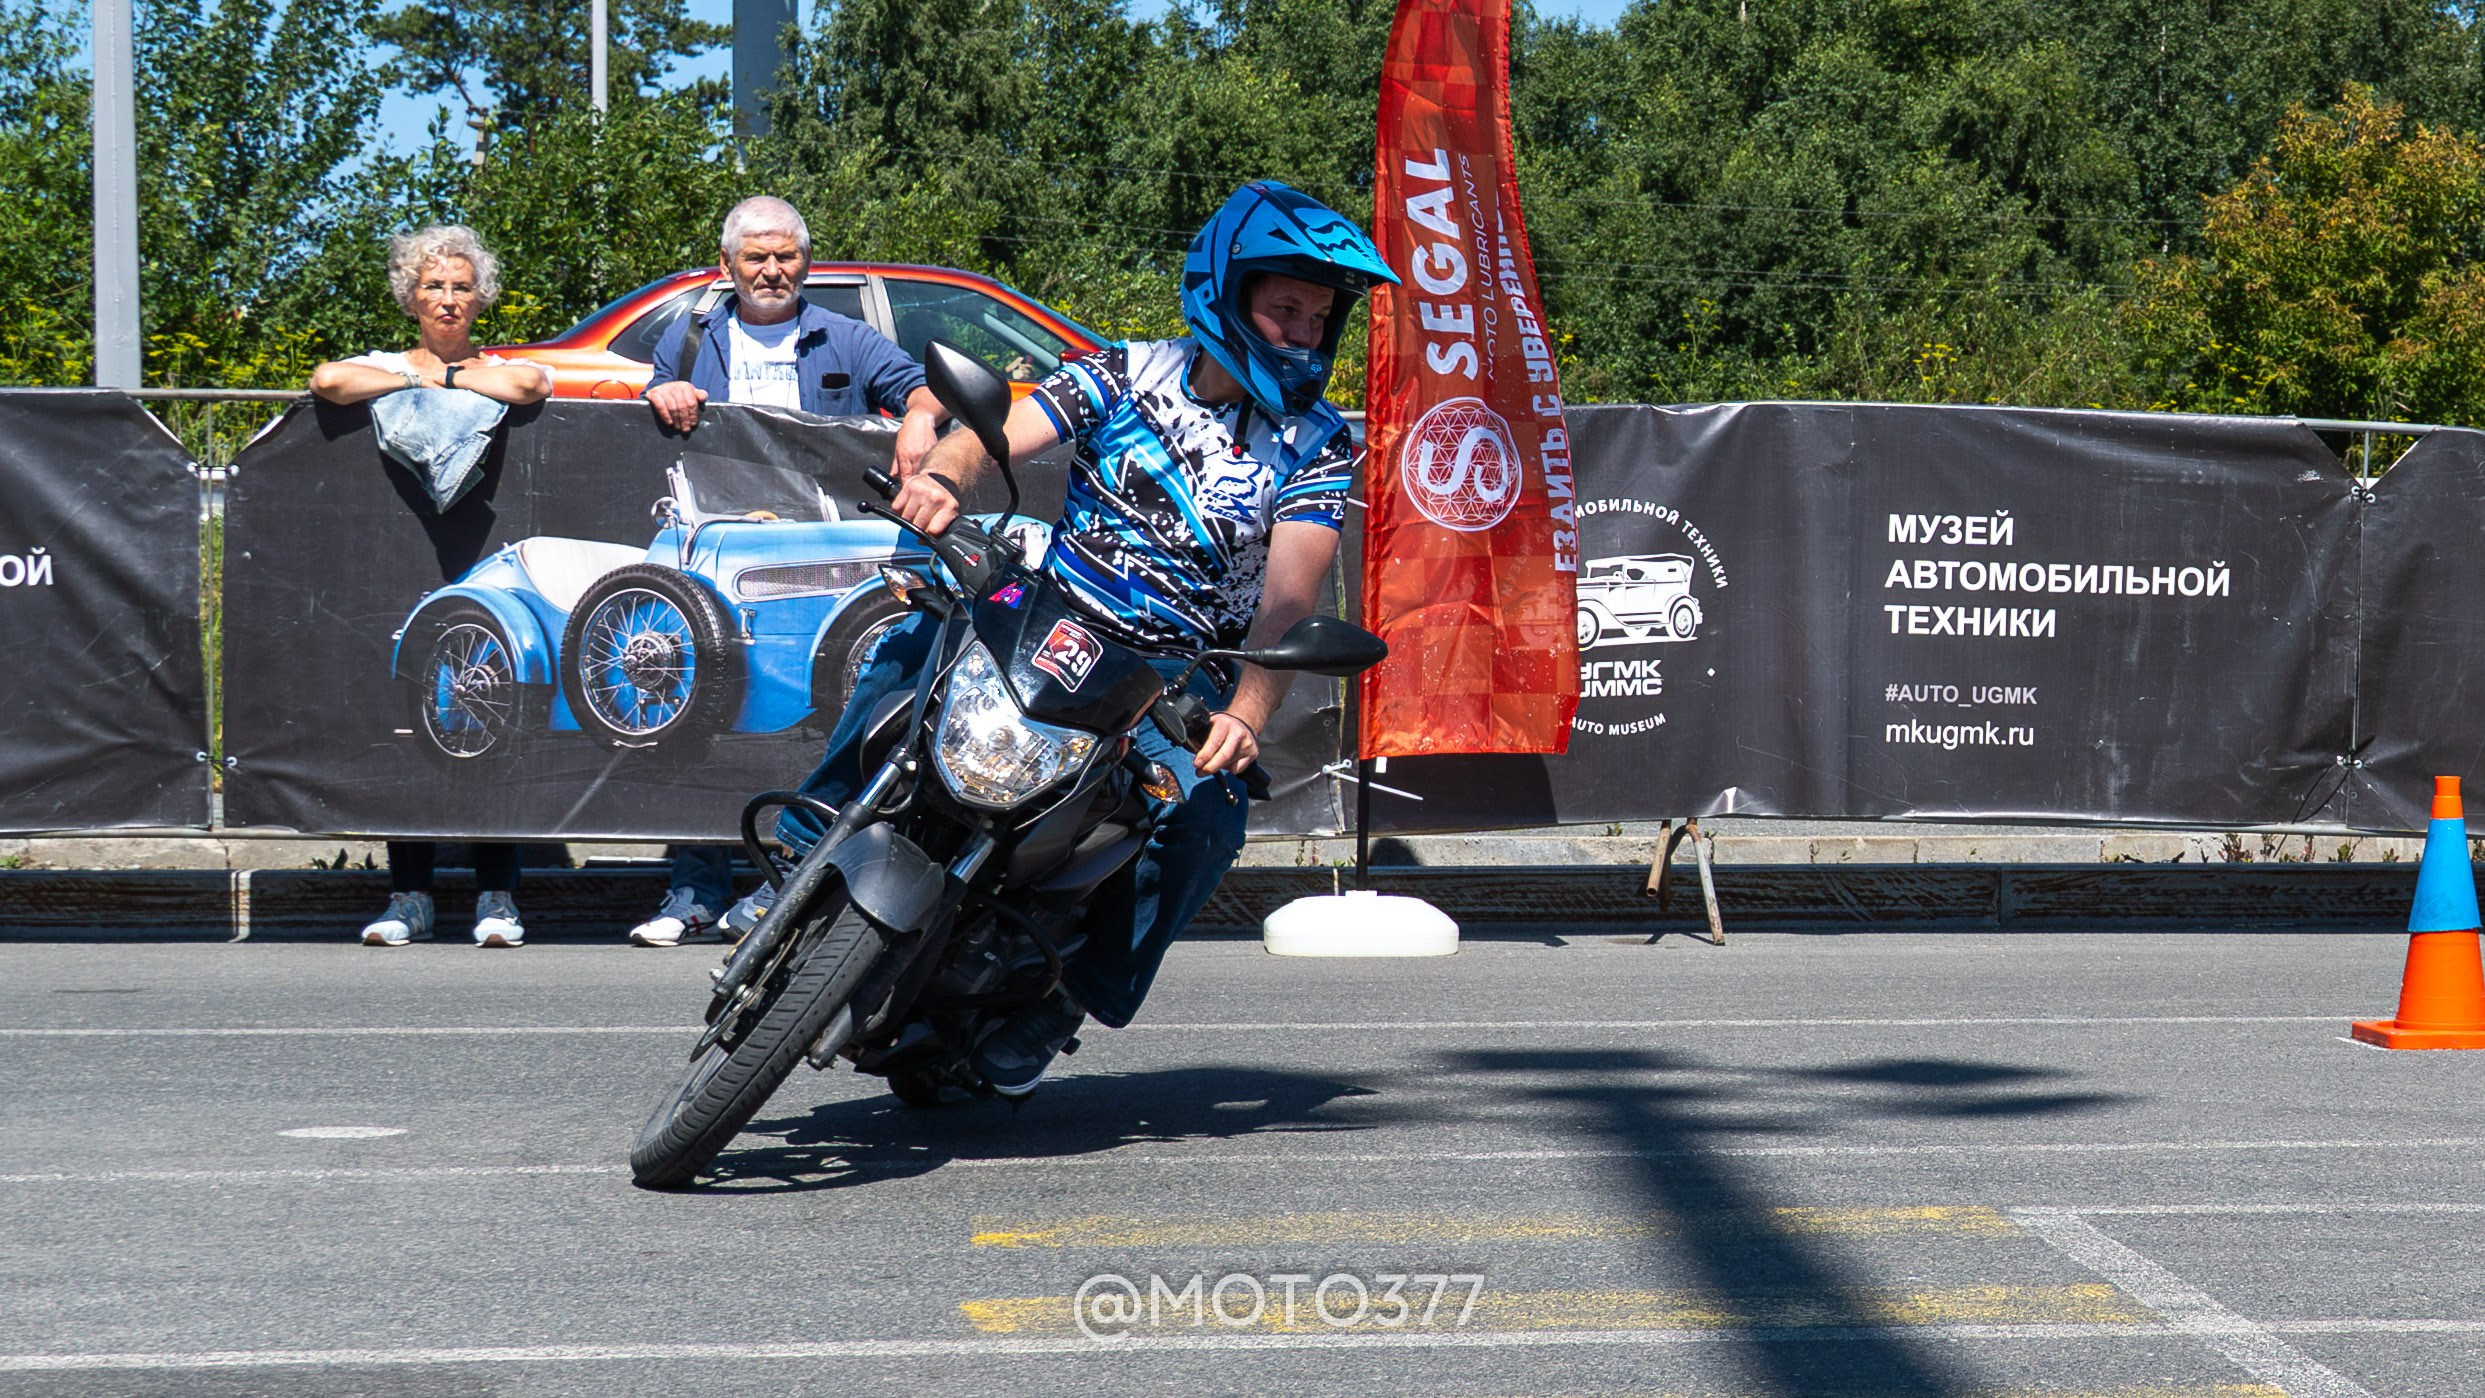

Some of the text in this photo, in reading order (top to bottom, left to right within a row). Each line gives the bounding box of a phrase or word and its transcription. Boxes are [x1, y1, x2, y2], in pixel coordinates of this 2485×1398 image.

[1458, 153, 1495, 301] LUBRICANTS
[1405, 148, 1479, 381] SEGAL
[1886, 510, 2014, 546] МУЗЕЙ
[1681, 520, 1729, 589] ТЕХНИКИ
[1885, 560, 2231, 597] АВТОМОБИЛЬНОЙ
[1884, 604, 2057, 637] ТЕХНИКИ
[1054, 639, 1092, 677] 29
[1885, 683, 2037, 707] #AUTO_UGMK
[1608, 712, 1667, 736] MUSEUM
[1885, 719, 2035, 750] mkugmk.ru
